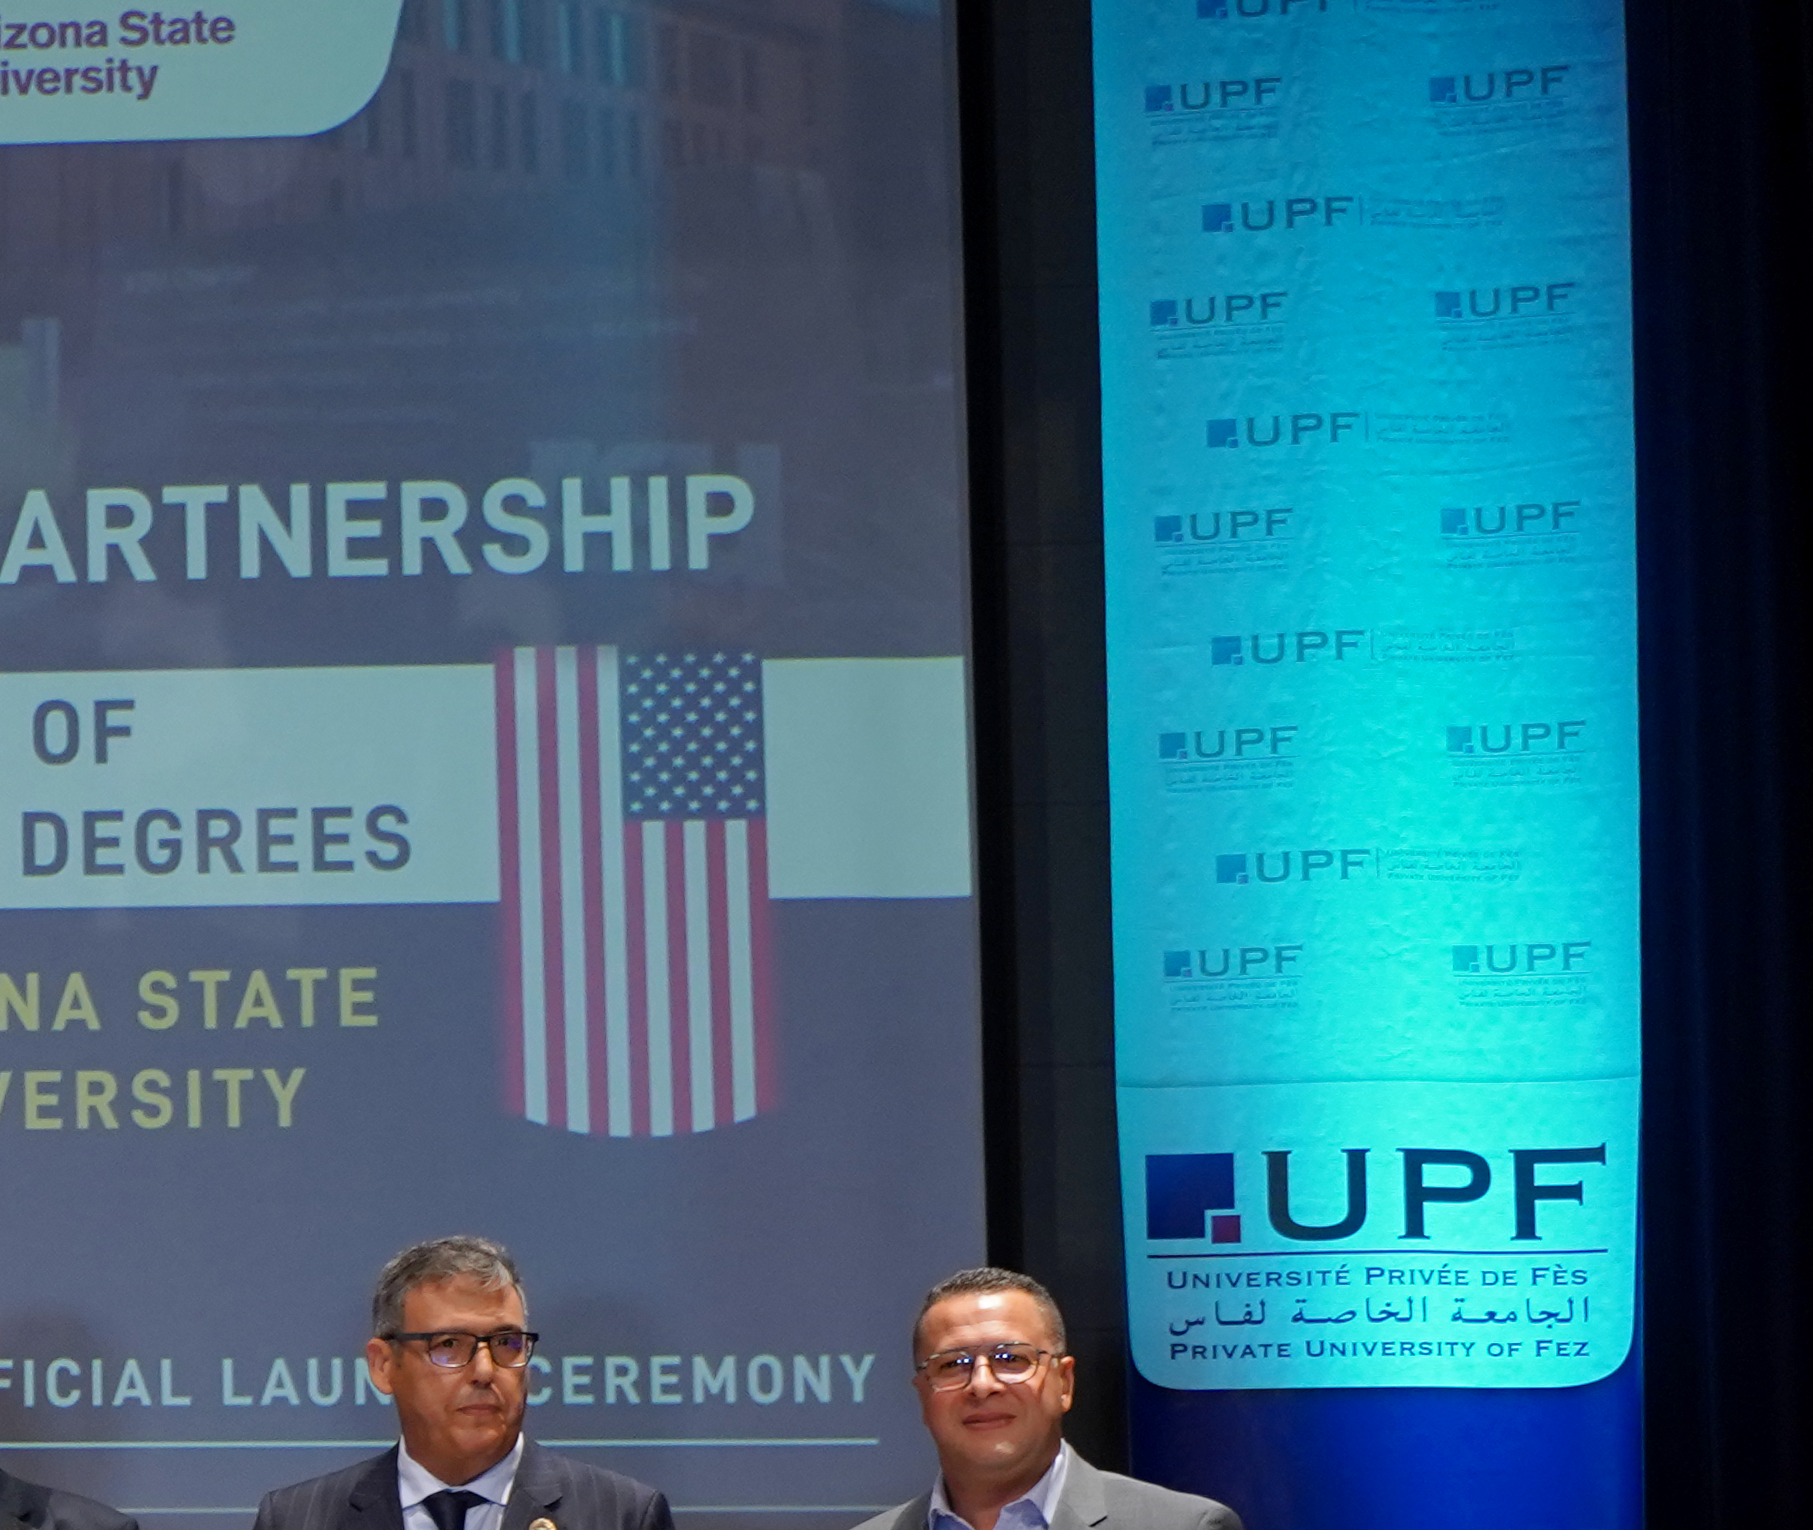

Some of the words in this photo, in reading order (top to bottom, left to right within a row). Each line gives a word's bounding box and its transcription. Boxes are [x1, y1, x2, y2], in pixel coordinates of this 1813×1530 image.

[119, 10, 235, 47] State
[1180, 77, 1282, 109] UPF
[1464, 65, 1571, 101] UPF
[1241, 196, 1353, 231] UPF
[1186, 292, 1287, 324] UPF
[1469, 282, 1576, 316] UPF
[1247, 413, 1360, 446] UPF
[1190, 508, 1292, 540] UPF
[1475, 501, 1580, 534] UPF
[1251, 630, 1365, 664] UPF
[33, 699, 135, 765] OF
[1195, 726, 1298, 759] UPF
[1480, 720, 1587, 753] UPF
[22, 805, 411, 877] DEGREES
[1256, 849, 1370, 882] UPF
[1199, 945, 1303, 979] UPF
[1485, 941, 1591, 973] UPF
[138, 967, 378, 1029] STATE
[1262, 1143, 1606, 1241] UPF
[1167, 1264, 1351, 1289] UNIVERSITÉ
[1365, 1263, 1469, 1285] PRIVÉE
[1481, 1270, 1517, 1286] DE
[1532, 1264, 1587, 1286] FÈS
[1169, 1299, 1265, 1336] لفاس
[1292, 1296, 1427, 1323] الخاصة
[1451, 1297, 1588, 1329] الجامعة
[1170, 1343, 1291, 1360] PRIVATE
[1306, 1340, 1475, 1357] UNIVERSITY
[1487, 1342, 1522, 1357] OF
[1536, 1340, 1589, 1357] FEZ
[222, 1357, 393, 1407] LAUN
[526, 1354, 875, 1405] CEREMONY
